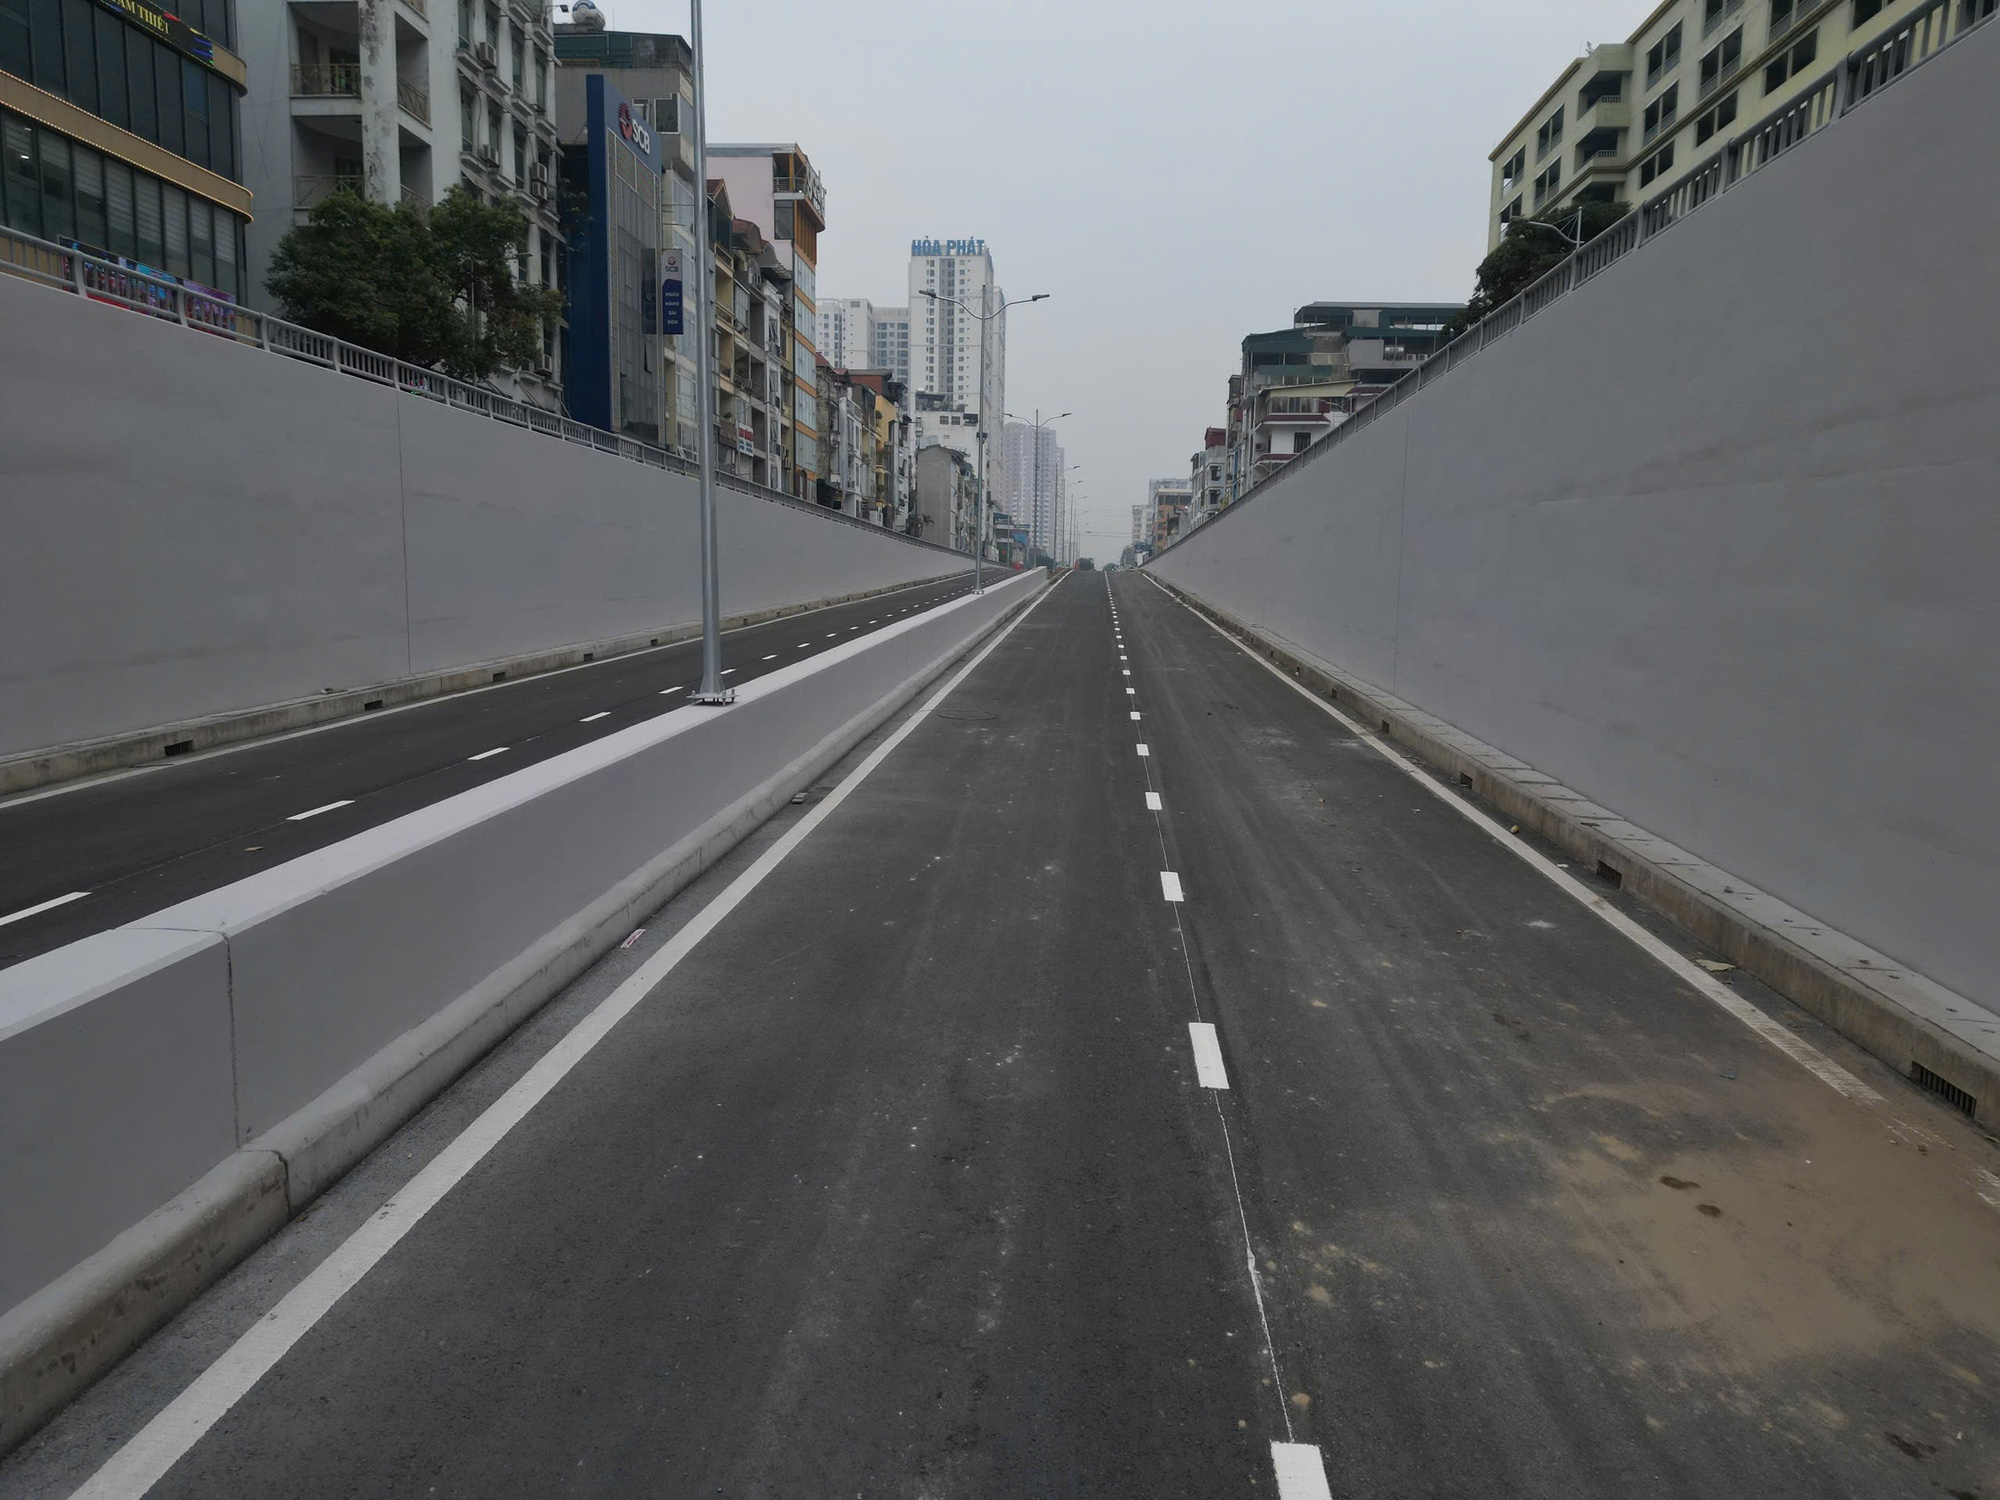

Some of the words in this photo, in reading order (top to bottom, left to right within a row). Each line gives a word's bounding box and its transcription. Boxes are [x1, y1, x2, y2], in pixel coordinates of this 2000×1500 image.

[632, 118, 650, 155] SCB
[911, 235, 942, 256] HÒA
[946, 236, 985, 256] PHÁT
